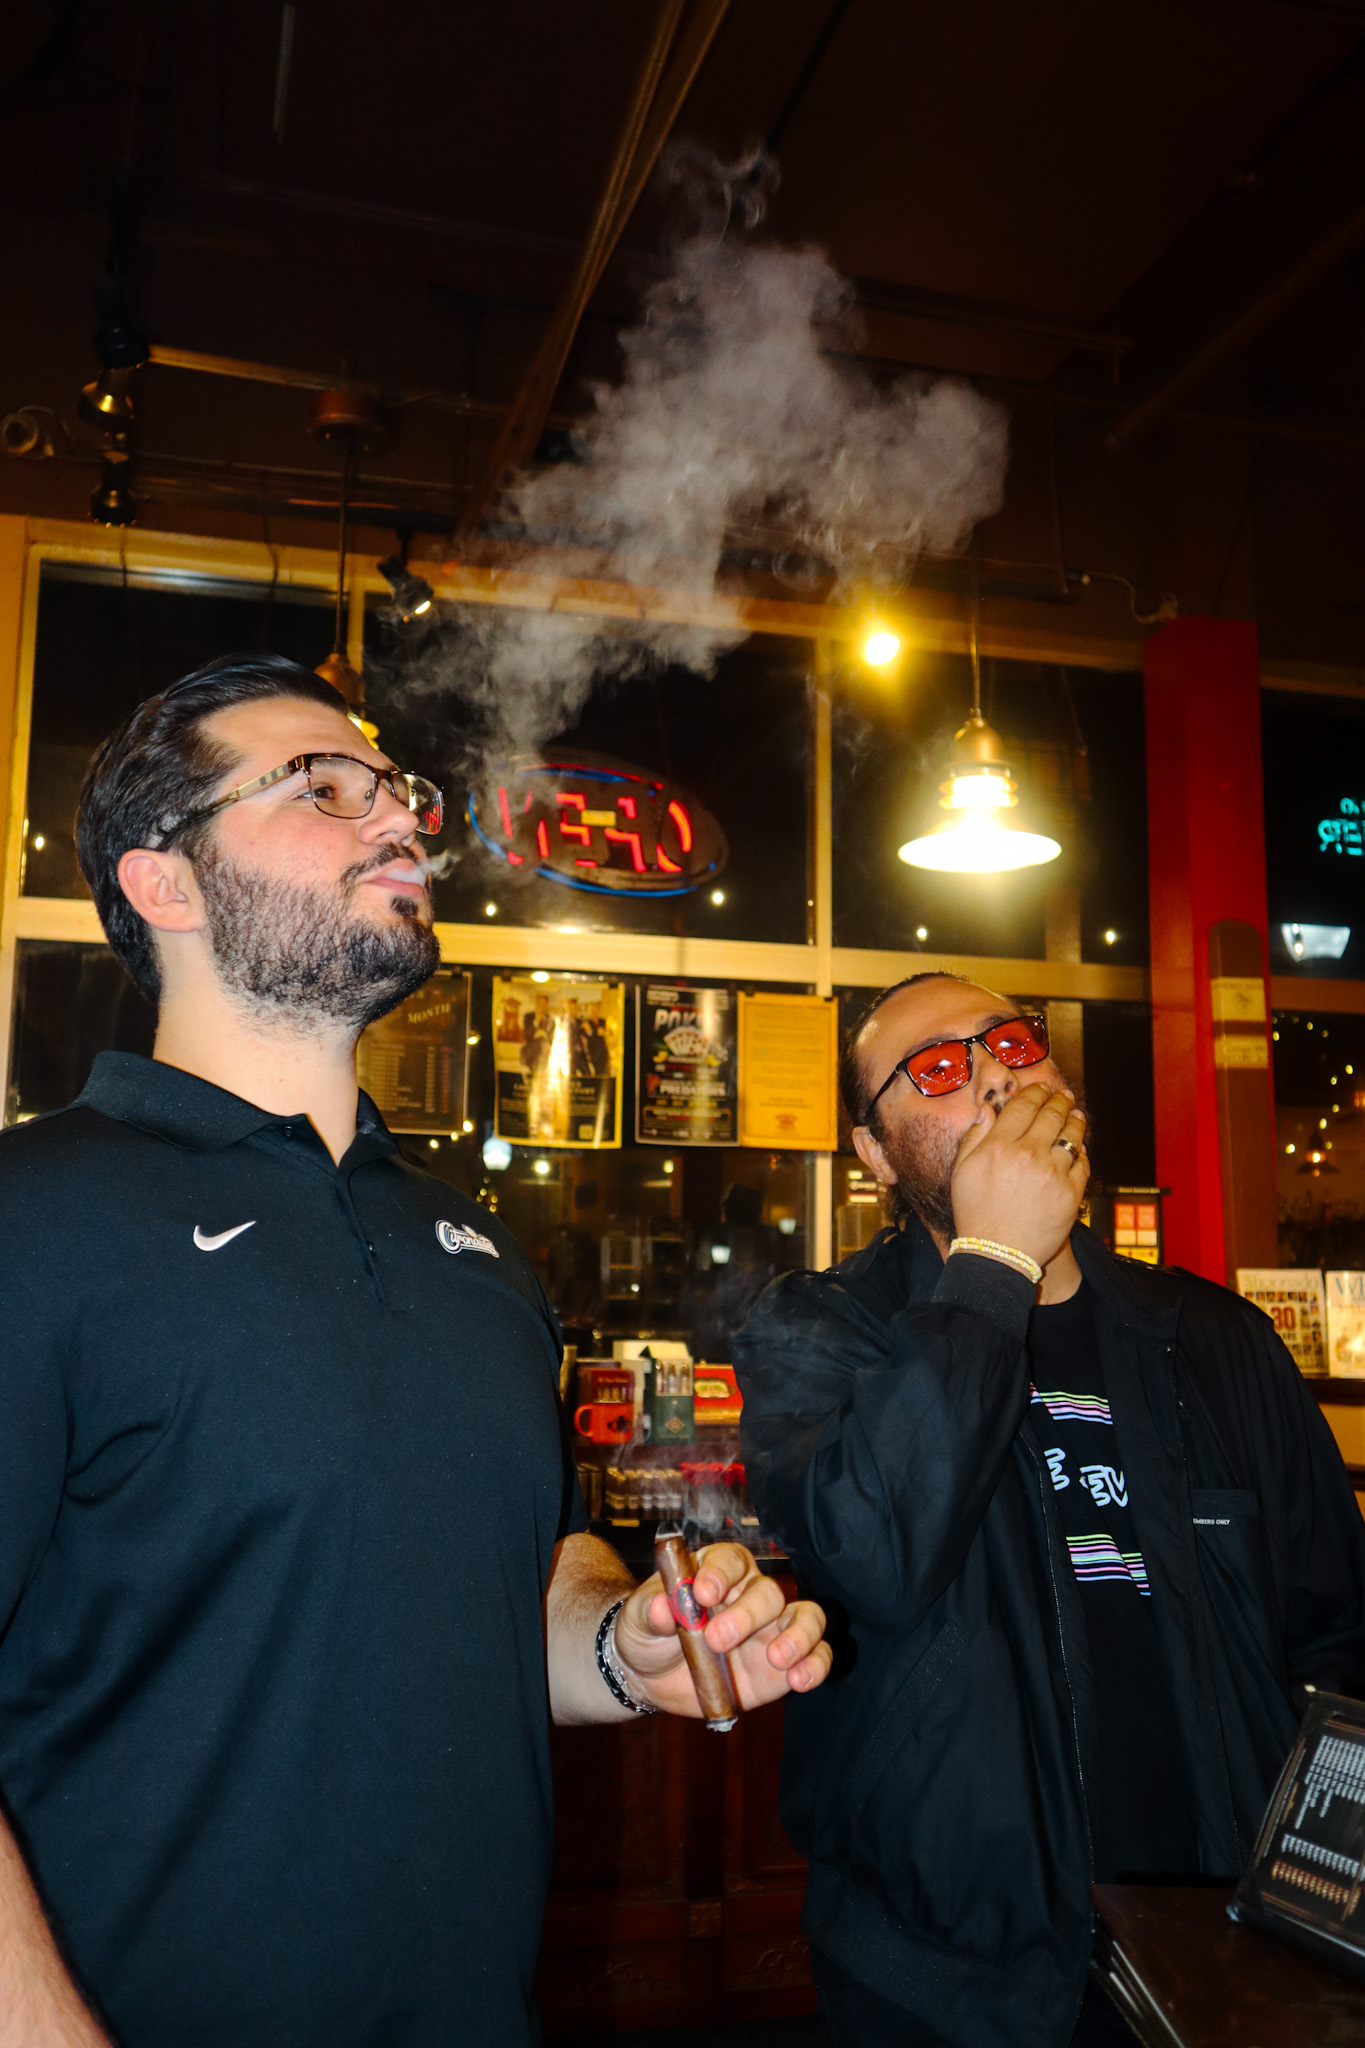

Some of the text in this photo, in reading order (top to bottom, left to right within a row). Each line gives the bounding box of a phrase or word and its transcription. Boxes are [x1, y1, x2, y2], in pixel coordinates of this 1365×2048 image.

[407, 1002, 451, 1024] MONTH
[1270, 1307, 1296, 1331] 30
[1216, 1518, 1231, 1526] ONLY
